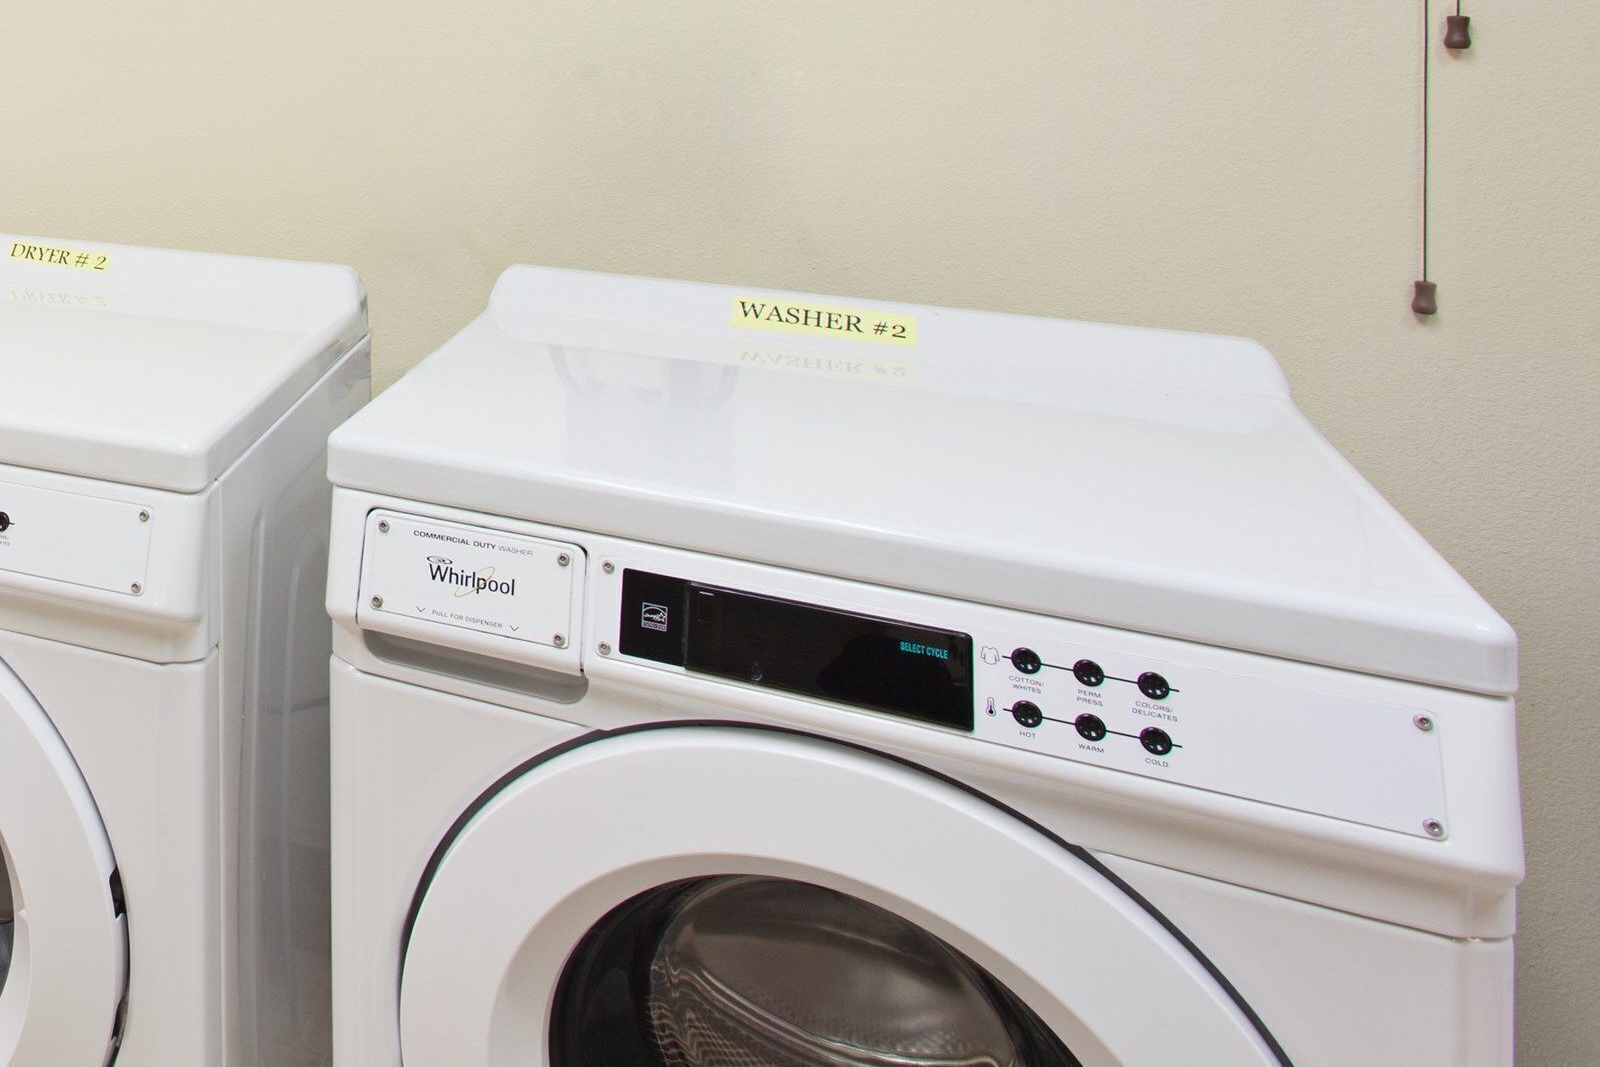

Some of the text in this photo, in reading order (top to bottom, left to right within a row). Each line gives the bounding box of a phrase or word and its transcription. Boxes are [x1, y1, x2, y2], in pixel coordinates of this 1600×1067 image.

[10, 243, 71, 265] DRYER
[94, 255, 107, 271] 2
[738, 300, 907, 339] WASHER #2
[413, 530, 533, 557] COMMERCIAL DUTY WASHER
[429, 563, 515, 596] Whirlpool
[431, 609, 503, 629] PULL FOR DISPENSER
[900, 640, 949, 660] SELECT CYCLE
[1012, 683, 1042, 695] WHITES
[1077, 688, 1102, 699] PERM
[1076, 696, 1104, 708] PRESS
[1131, 707, 1178, 723] DELICATES
[1019, 730, 1036, 740] HOT
[1077, 743, 1105, 754] WARM
[1144, 757, 1169, 768] COLD
